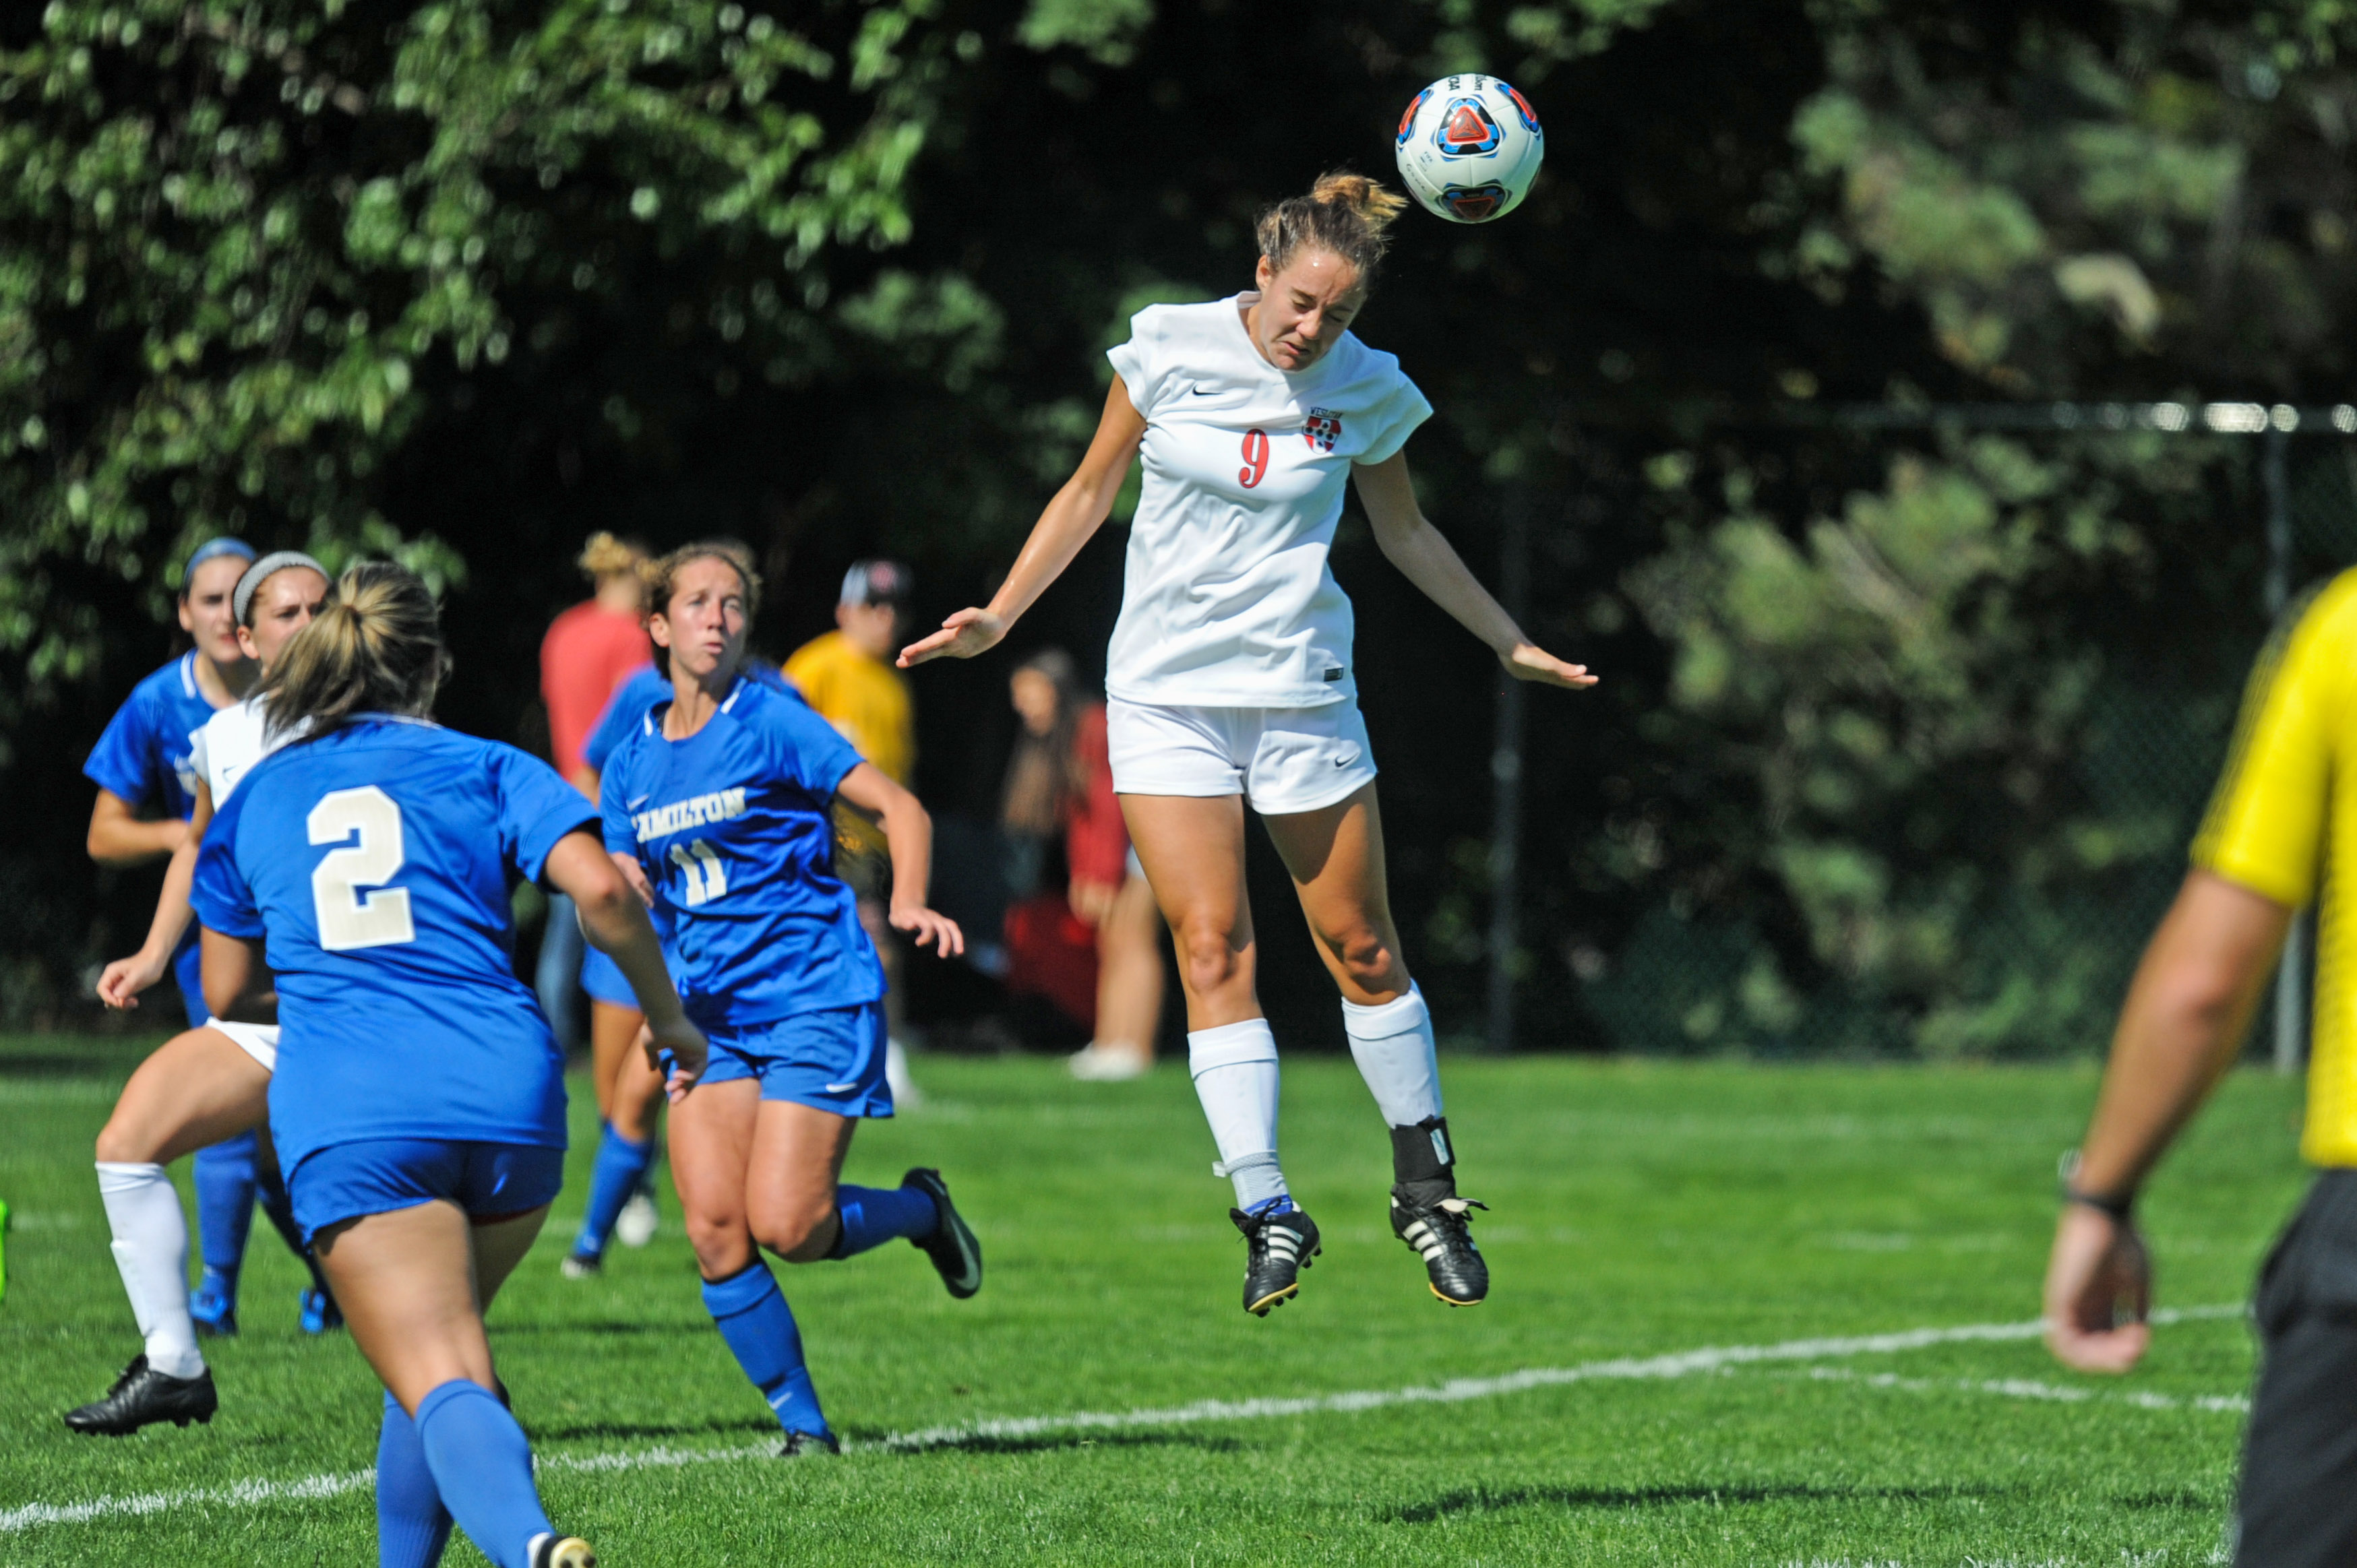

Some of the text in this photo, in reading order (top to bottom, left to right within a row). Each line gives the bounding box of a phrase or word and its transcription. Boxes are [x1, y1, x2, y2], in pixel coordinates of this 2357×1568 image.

[1448, 76, 1460, 91] CAA
[1474, 74, 1487, 90] lson
[1239, 429, 1269, 489] 9
[631, 786, 746, 844] AMILTON
[307, 784, 416, 951] 2
[670, 838, 727, 907] 11
